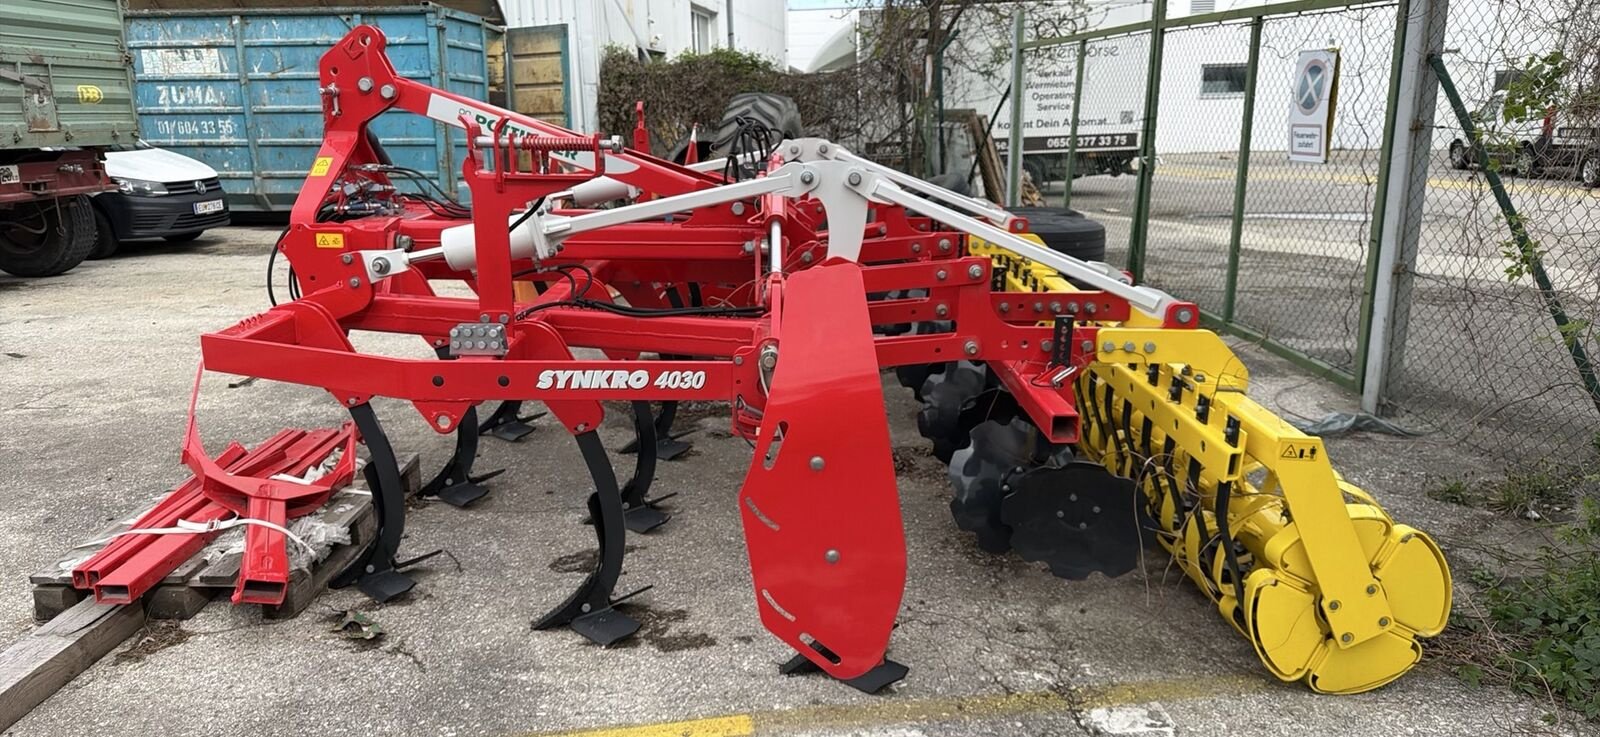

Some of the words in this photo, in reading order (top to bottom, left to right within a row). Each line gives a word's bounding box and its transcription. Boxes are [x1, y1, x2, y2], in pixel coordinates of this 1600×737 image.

[1026, 80, 1076, 90] Vermietun
[156, 85, 218, 105] ZUMA
[1037, 103, 1070, 112] Service
[201, 120, 216, 134] 33
[1036, 119, 1060, 129] Dein
[1062, 117, 1117, 128] Atomat...
[476, 112, 578, 161] PTTIER
[1077, 135, 1097, 147] 377
[1098, 135, 1111, 146] 33
[1113, 134, 1127, 145] 75
[536, 369, 650, 390] SYNKRO
[653, 370, 706, 390] 4030
